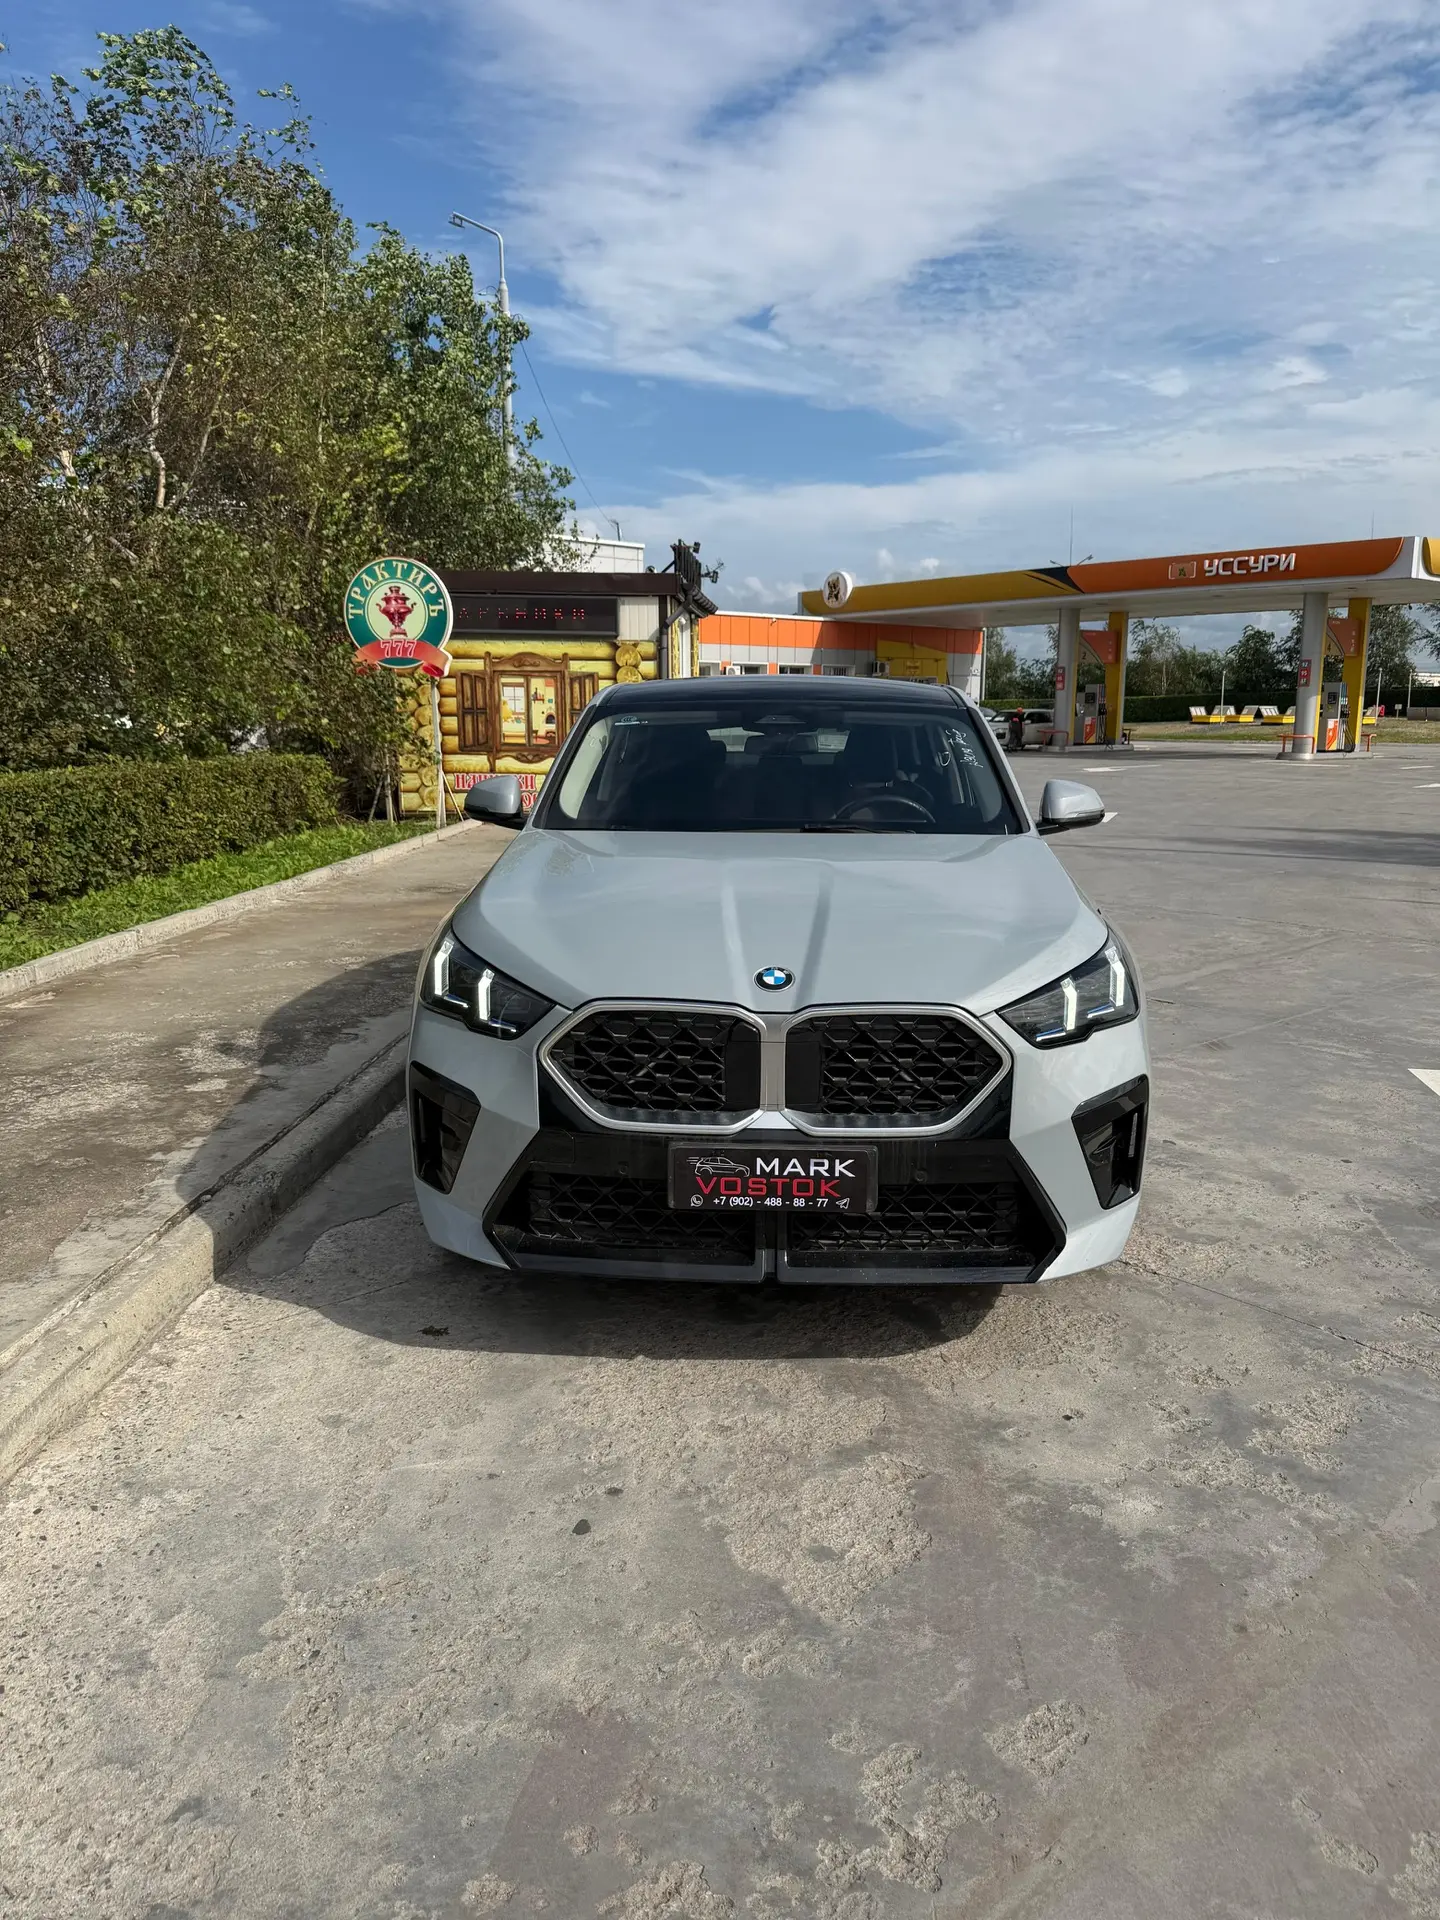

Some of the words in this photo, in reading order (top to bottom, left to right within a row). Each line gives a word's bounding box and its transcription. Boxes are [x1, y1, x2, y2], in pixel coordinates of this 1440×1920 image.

[1204, 552, 1296, 577] УССУРИ
[348, 561, 445, 619] ТРАКТИРЪ
[380, 639, 418, 658] 777
[756, 1157, 856, 1177] MARK
[695, 1176, 841, 1197] VOSTOK
[713, 1196, 726, 1206] +7
[729, 1196, 754, 1207] (902)
[764, 1197, 782, 1207] 488
[793, 1198, 805, 1207] 88
[816, 1198, 829, 1208] 77
